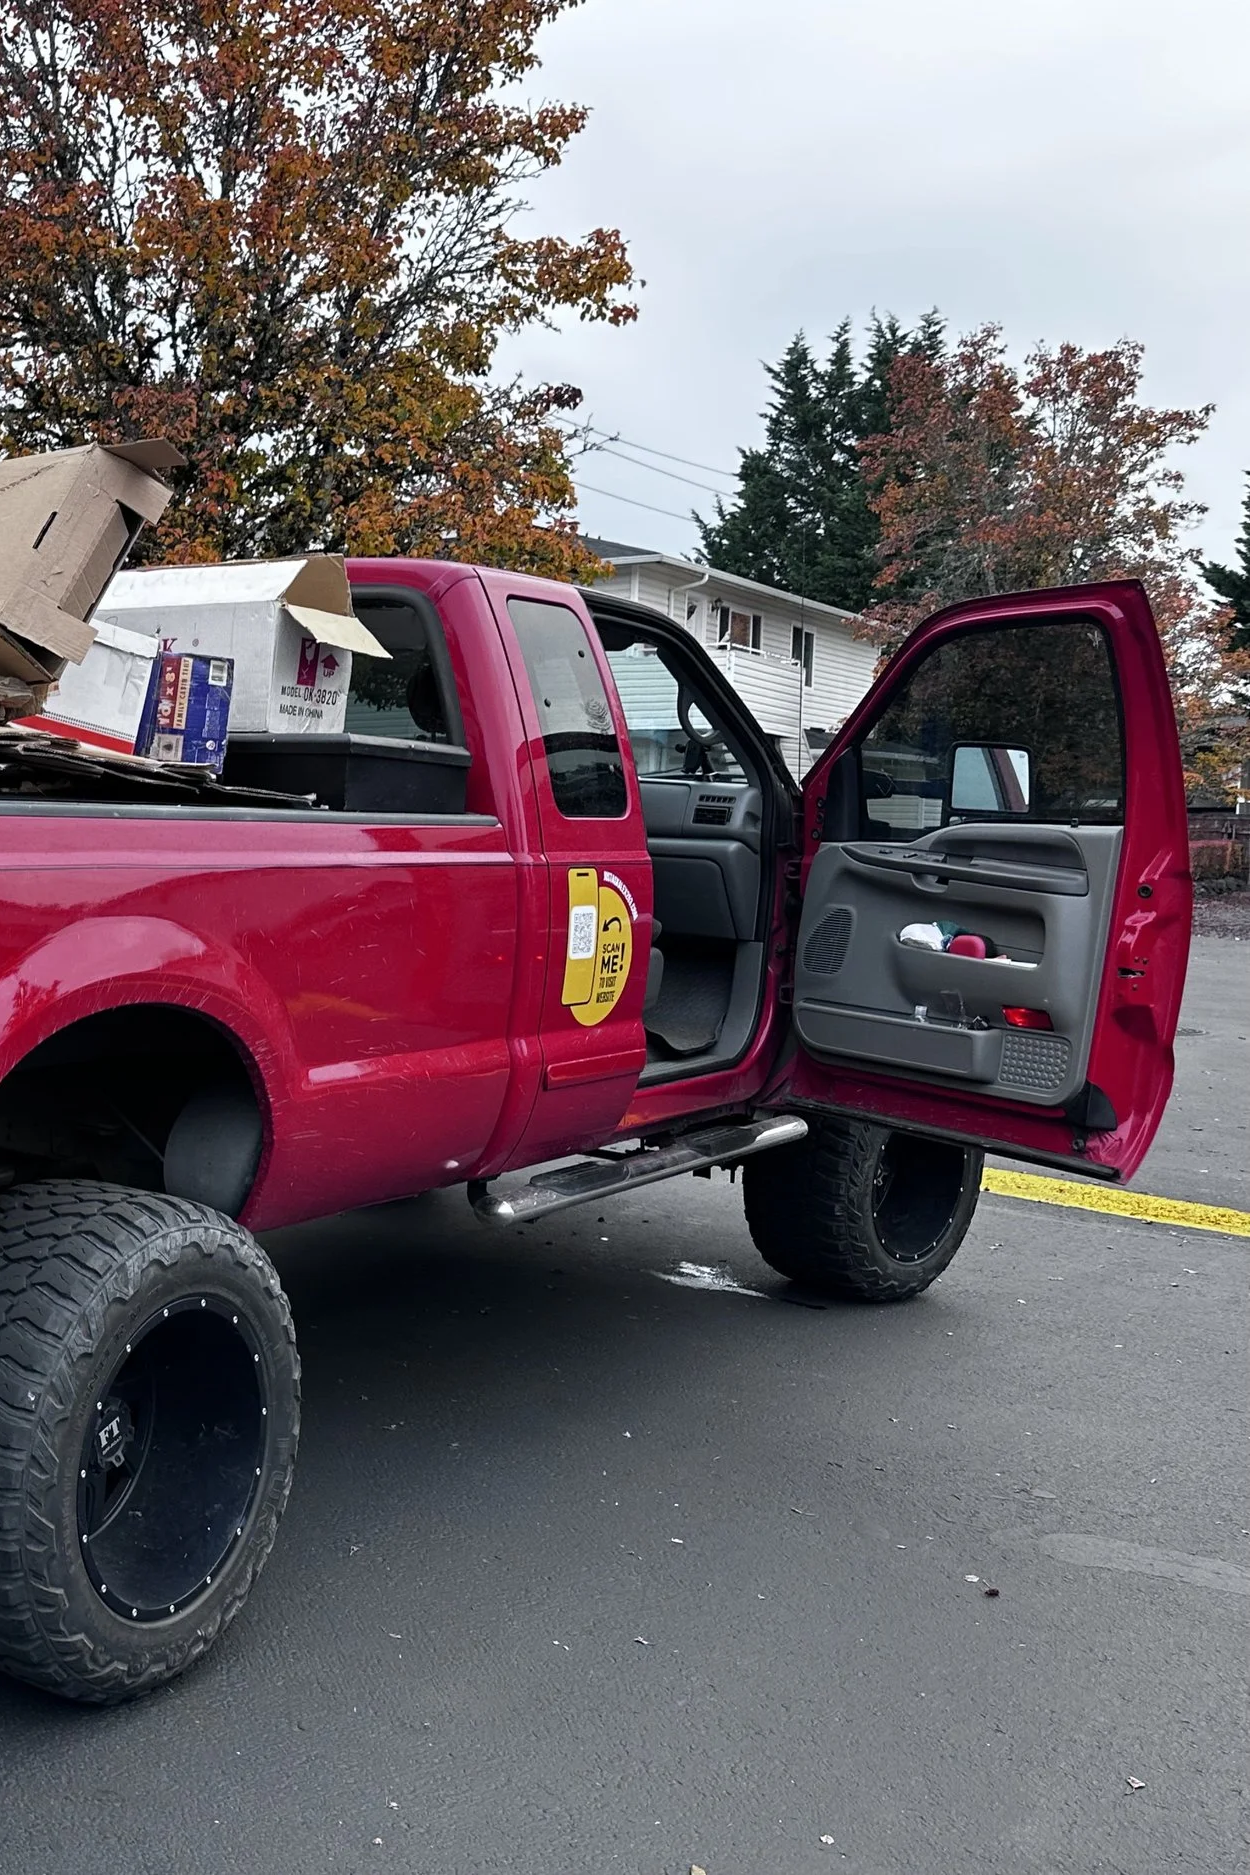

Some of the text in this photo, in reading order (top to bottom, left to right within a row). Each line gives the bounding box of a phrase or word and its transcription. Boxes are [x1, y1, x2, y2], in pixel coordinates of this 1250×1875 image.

[323, 670, 335, 678] UP
[179, 679, 189, 700] CABIN
[280, 685, 302, 698] MODEL
[175, 701, 187, 728] FAMILY
[279, 703, 323, 719] MADE IN CHINA
[602, 943, 620, 954] SCAN
[599, 976, 617, 988] TO VISIT
[98, 1416, 120, 1448] FT
